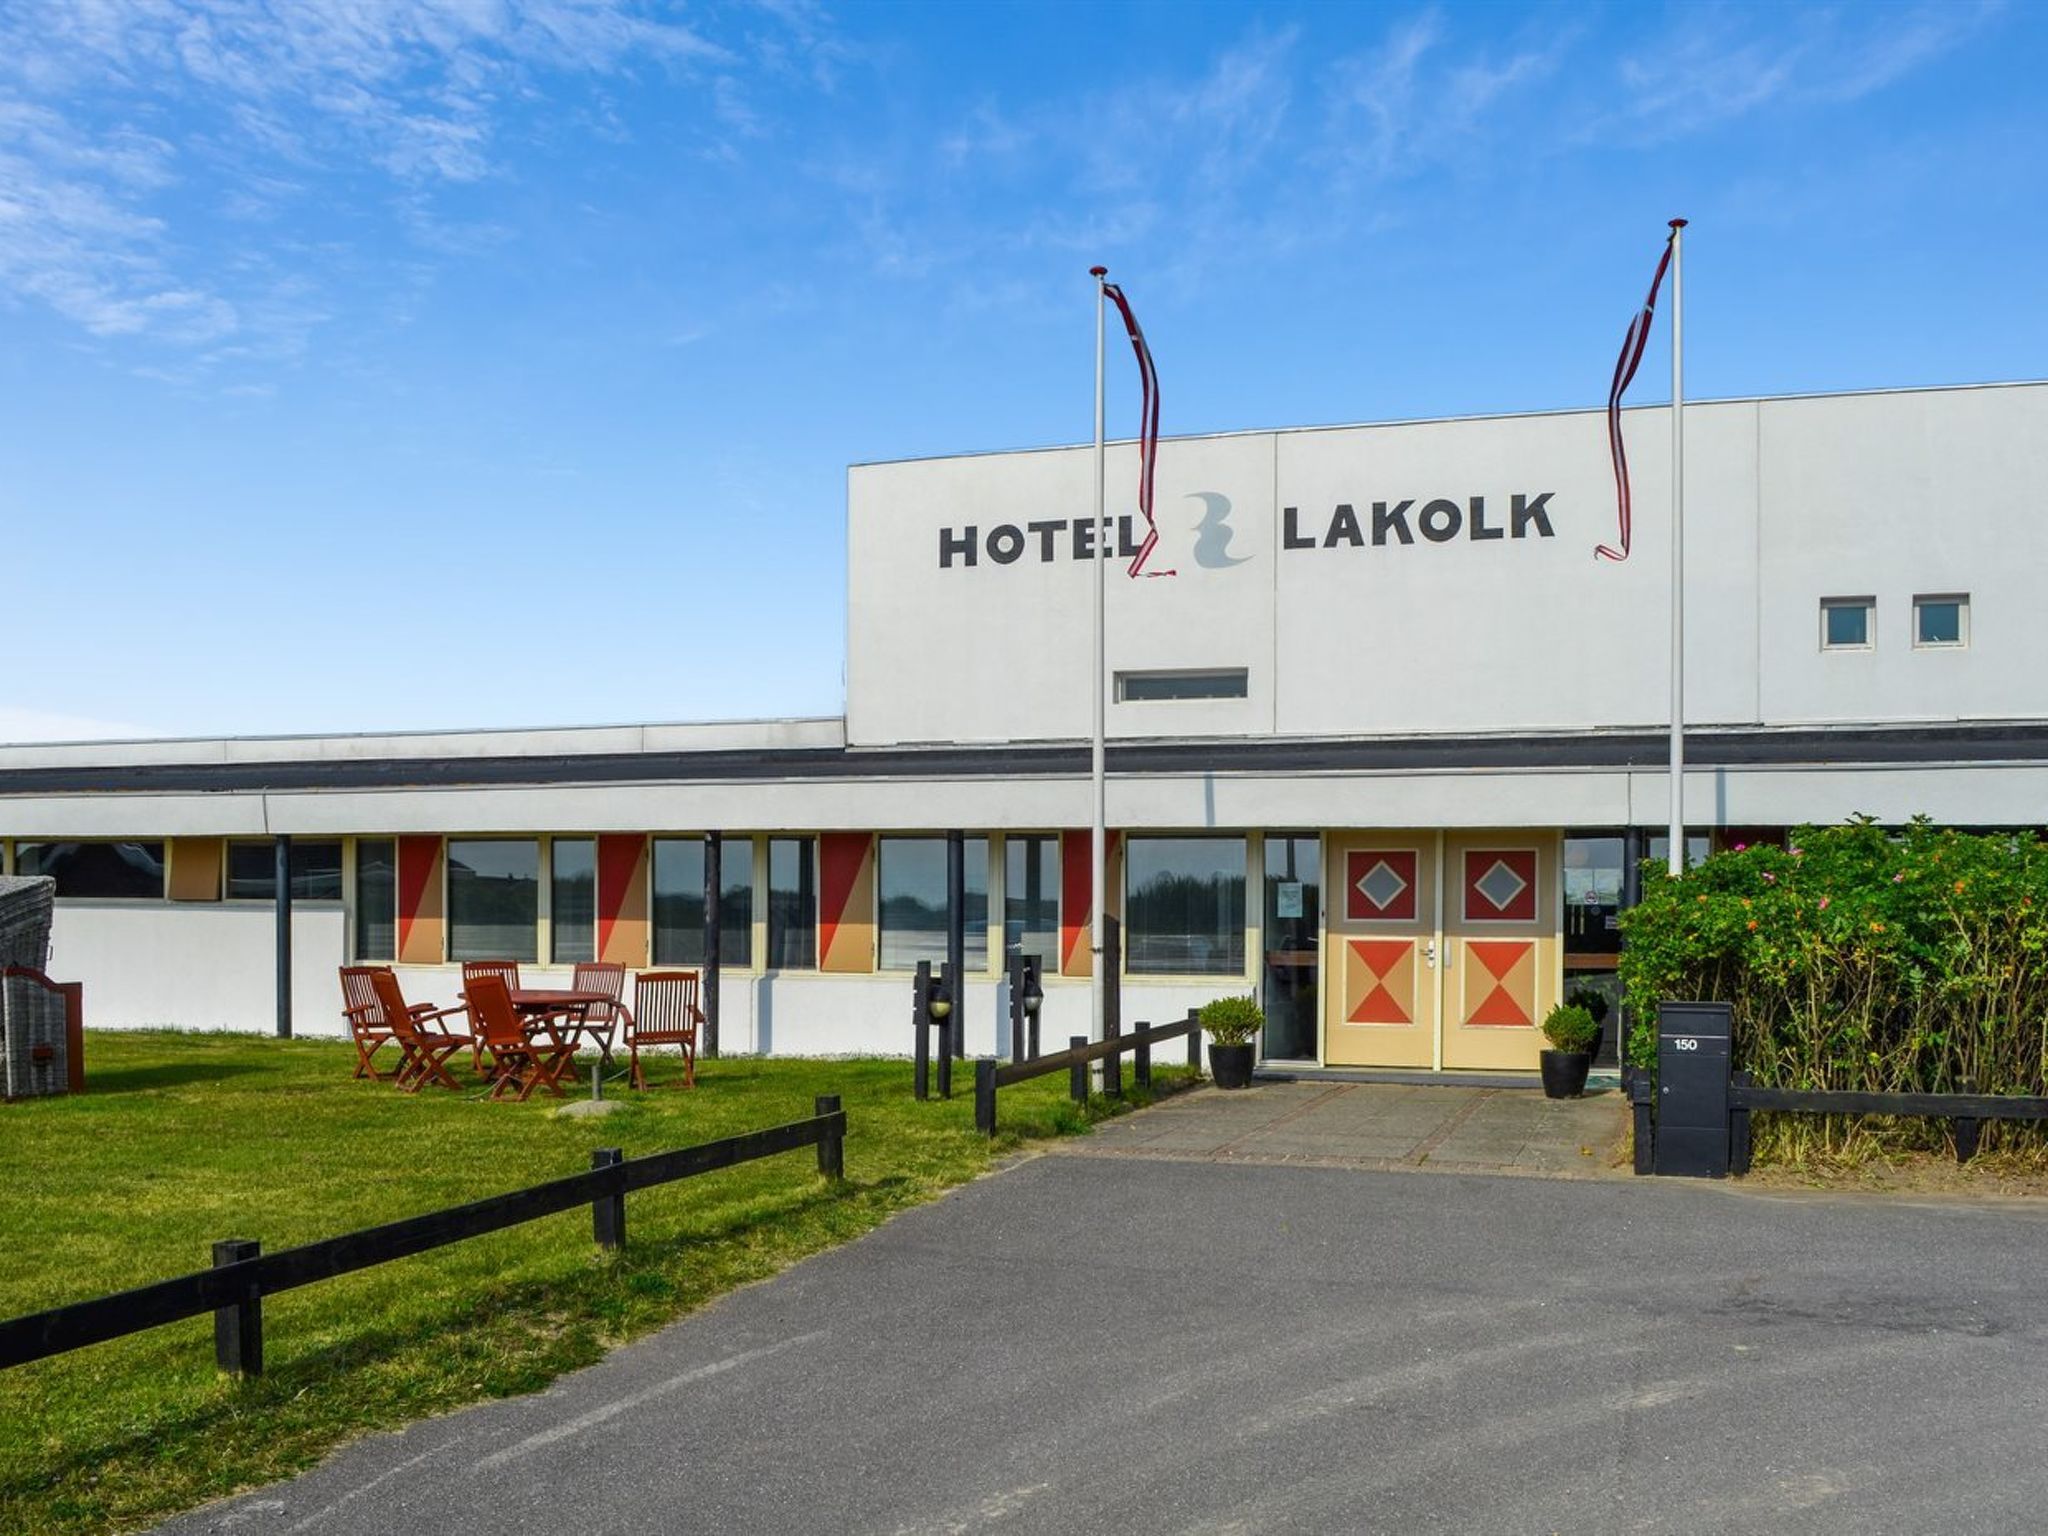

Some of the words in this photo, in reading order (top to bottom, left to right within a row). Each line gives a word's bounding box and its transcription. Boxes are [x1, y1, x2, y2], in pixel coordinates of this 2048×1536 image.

[939, 515, 1145, 568] HOTEL
[1283, 493, 1556, 550] LAKOLK
[1674, 1039, 1698, 1051] 150
